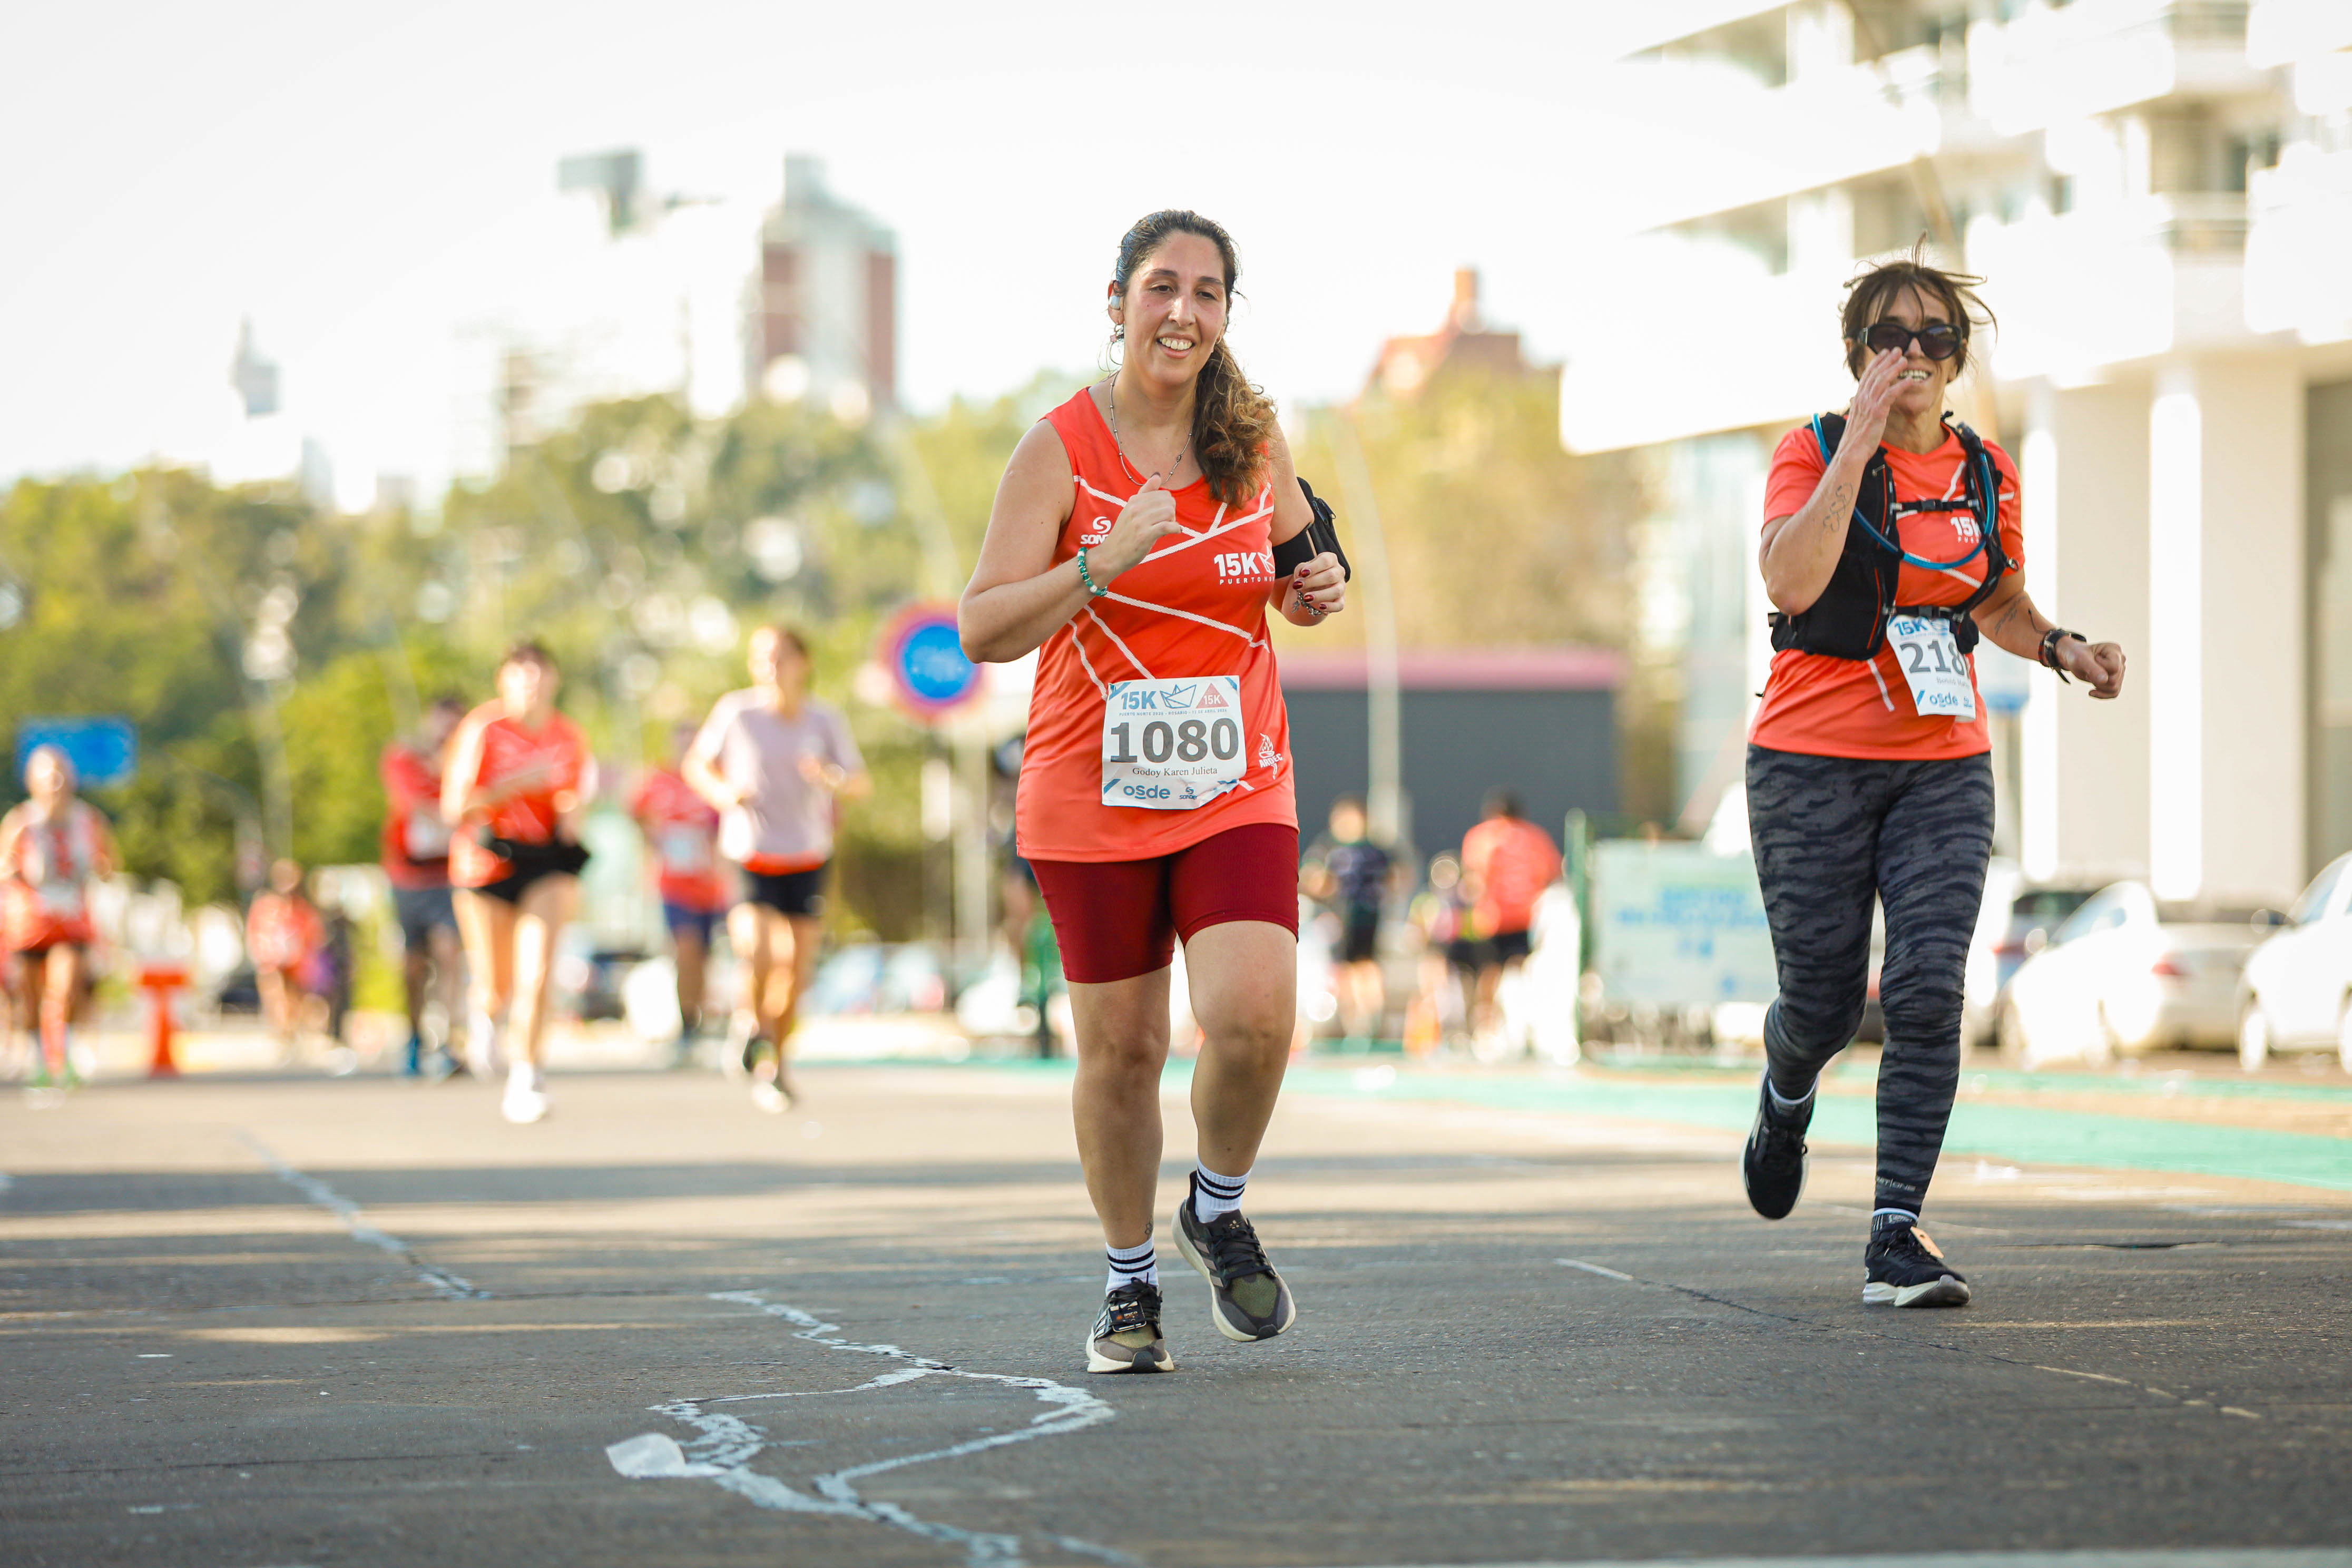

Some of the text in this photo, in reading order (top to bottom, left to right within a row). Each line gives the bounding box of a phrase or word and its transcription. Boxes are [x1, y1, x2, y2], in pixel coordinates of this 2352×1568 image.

[1080, 534, 1109, 544] SON
[1214, 552, 1260, 577] 15K
[1220, 576, 1261, 585] PUERTO
[1895, 616, 1928, 635] 15K
[1899, 640, 1966, 676] 218
[1121, 691, 1221, 710] 15K 15K
[1110, 718, 1239, 763] 1080
[1259, 753, 1283, 768] ARDEC
[1132, 766, 1218, 778] Godoy Karen Julieta
[1123, 785, 1171, 800] osde
